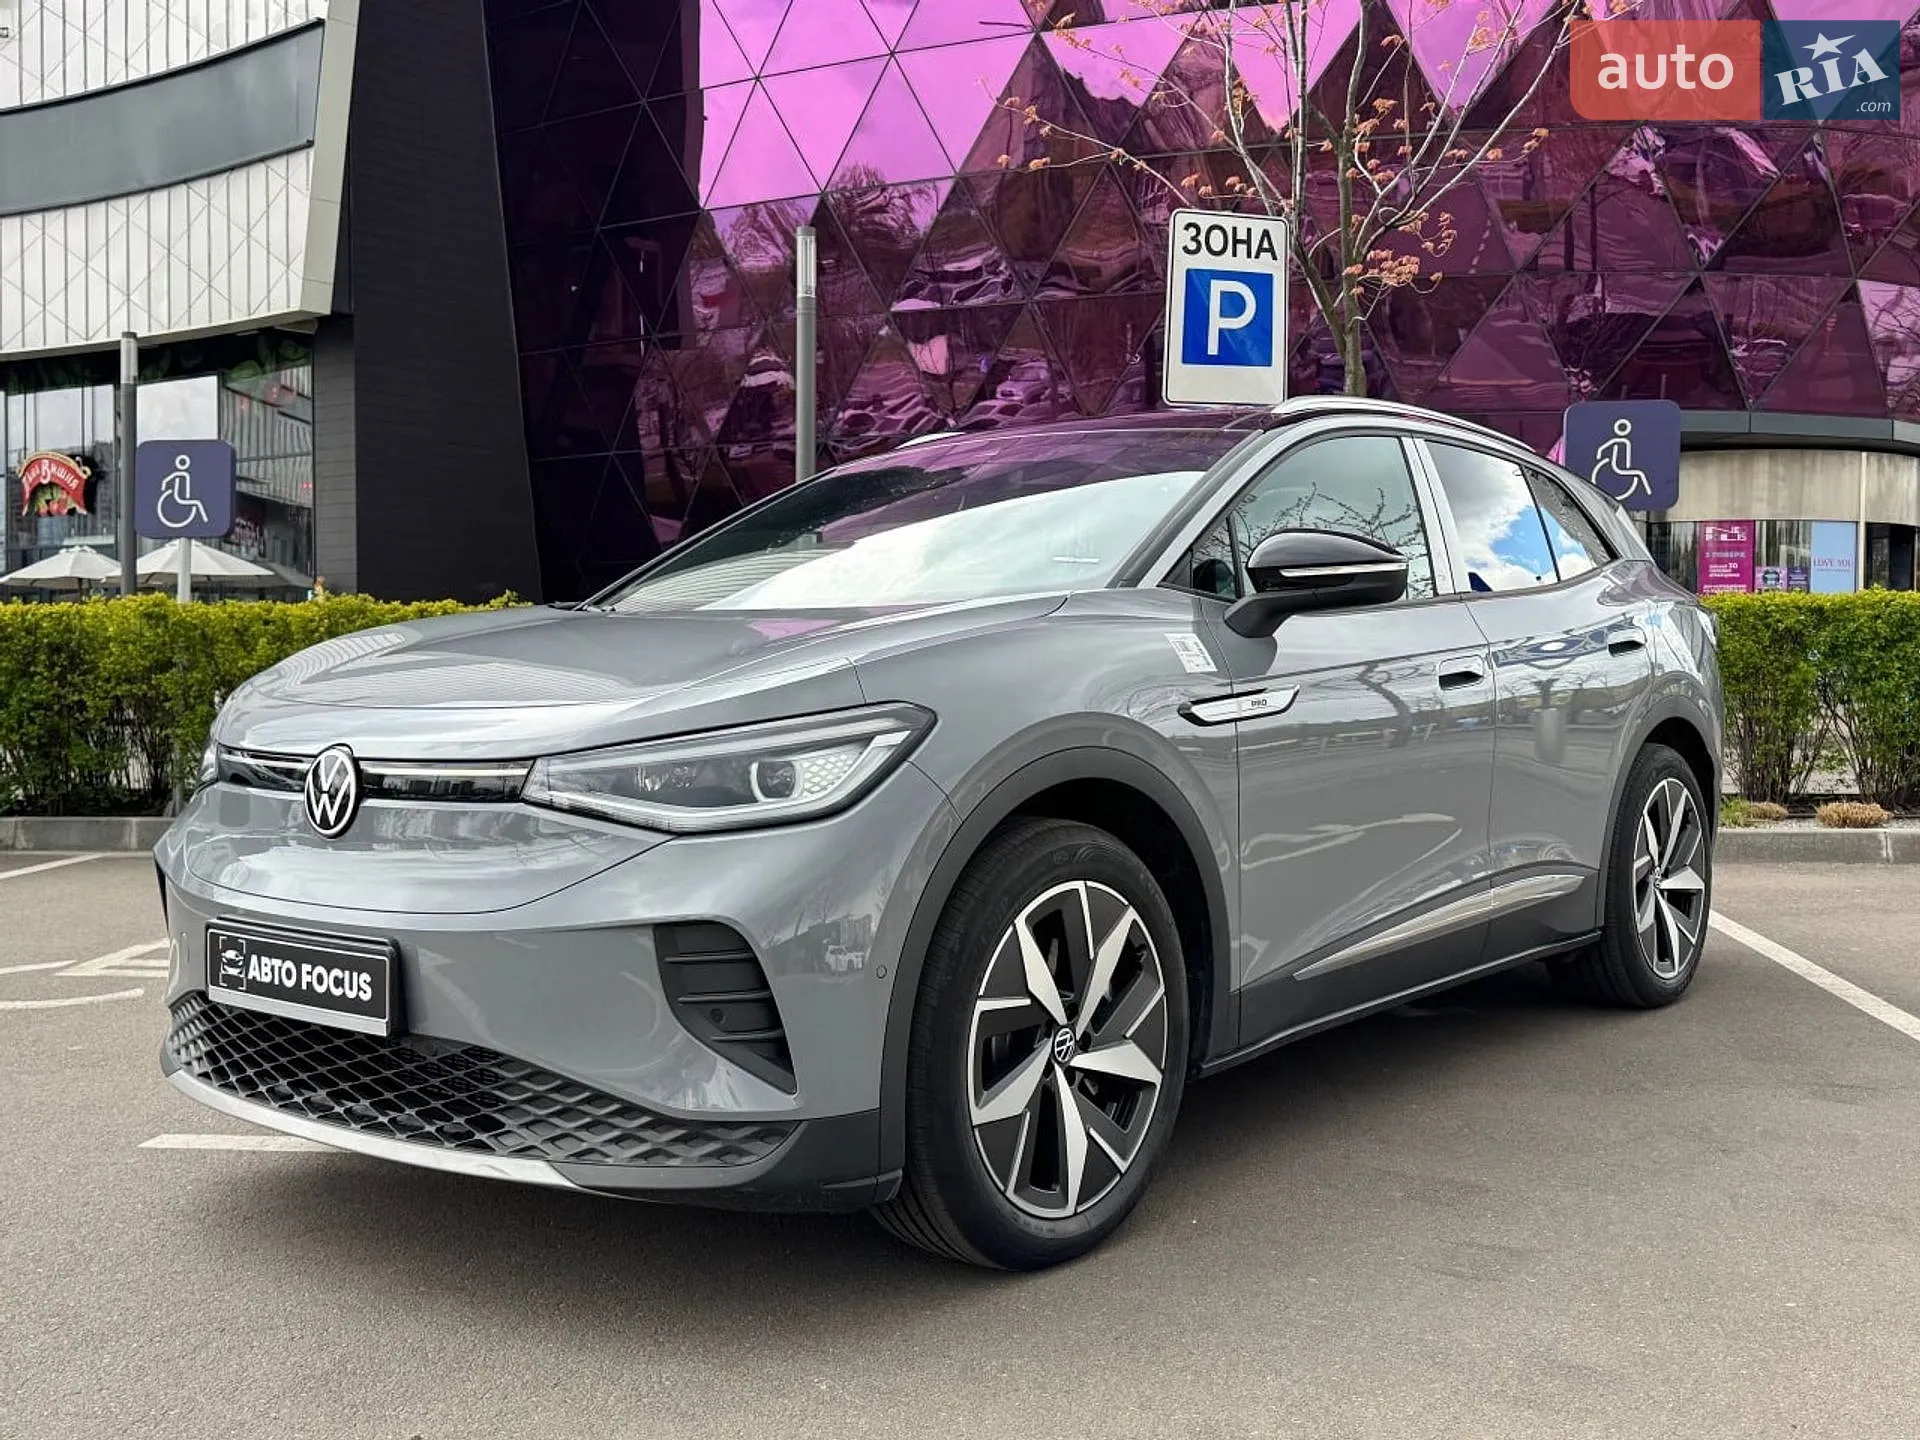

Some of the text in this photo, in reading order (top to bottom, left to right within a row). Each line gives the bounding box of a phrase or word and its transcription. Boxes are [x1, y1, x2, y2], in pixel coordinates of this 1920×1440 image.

[1182, 222, 1278, 261] ЗОНА
[1207, 279, 1257, 356] P
[301, 963, 372, 1002] FOCUS
